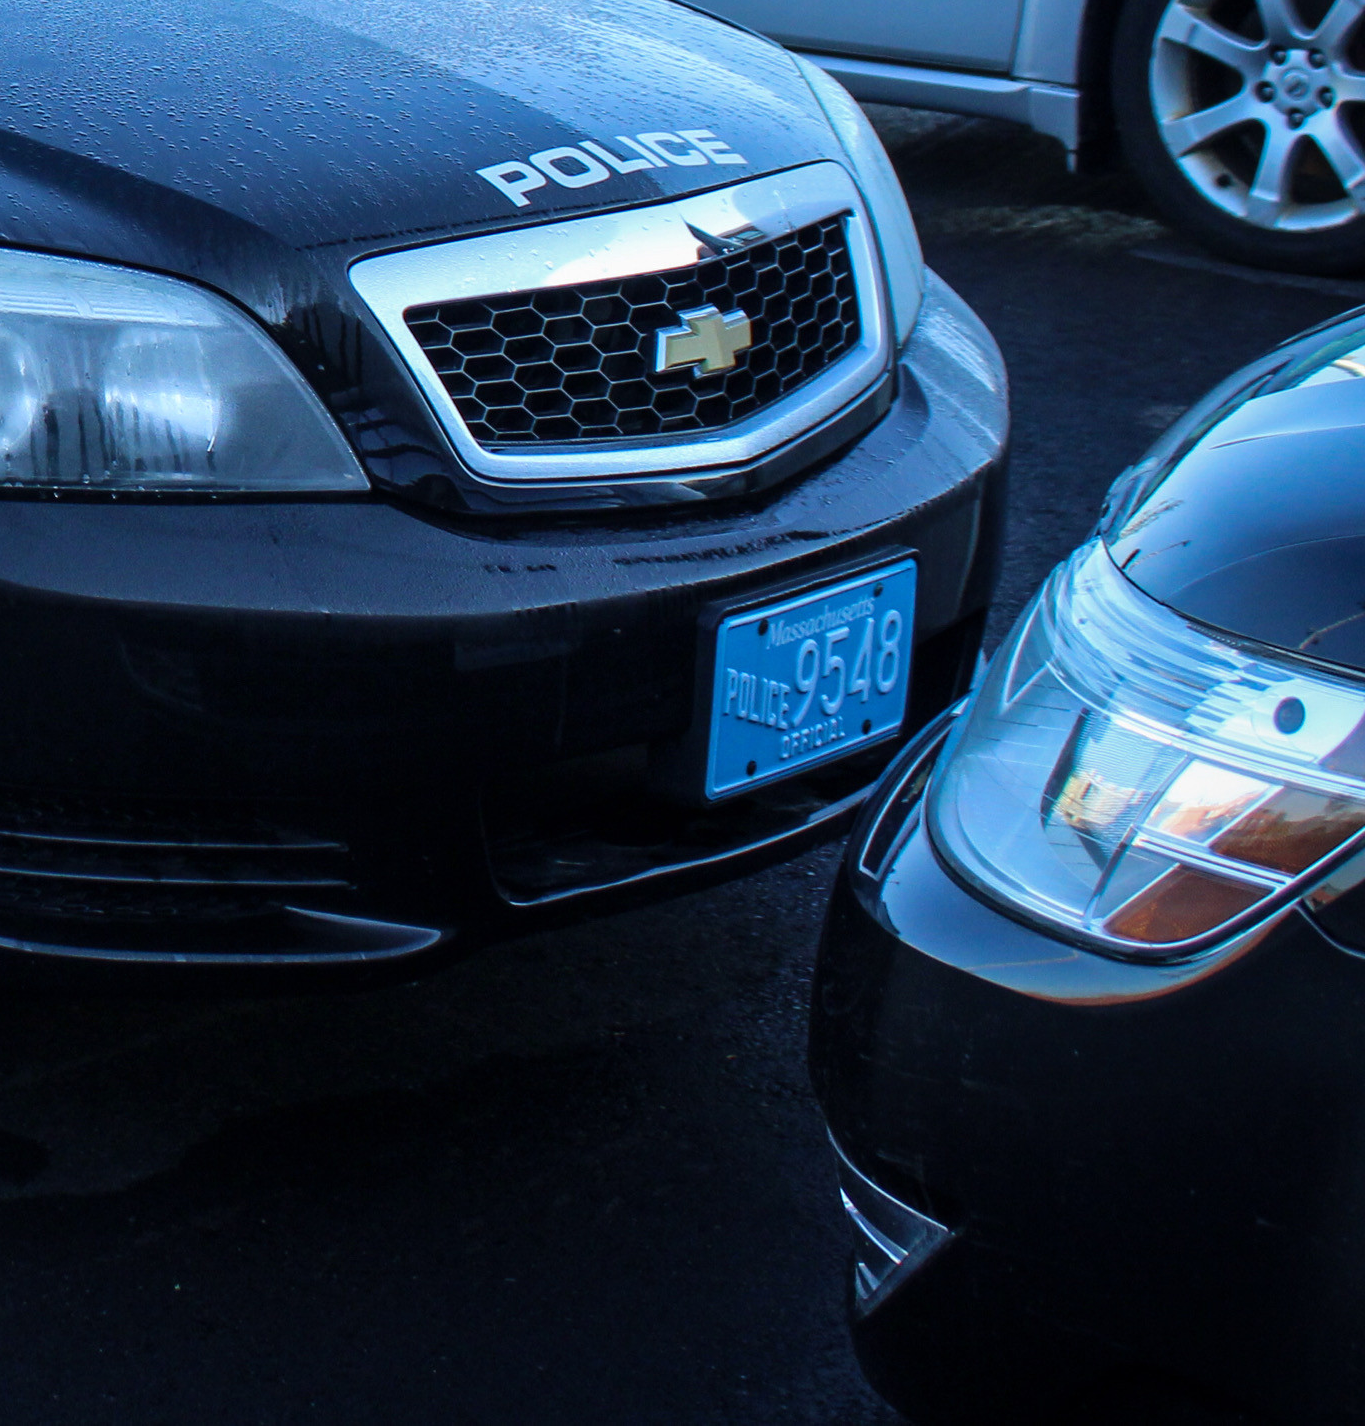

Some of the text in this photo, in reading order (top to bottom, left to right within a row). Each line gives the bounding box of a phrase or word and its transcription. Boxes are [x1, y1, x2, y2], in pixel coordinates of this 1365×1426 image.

[475, 129, 748, 207] POLICE
[766, 596, 876, 649] Massachusetts
[723, 609, 903, 731] POLICE 9548
[779, 716, 846, 760] OFFICIAL
